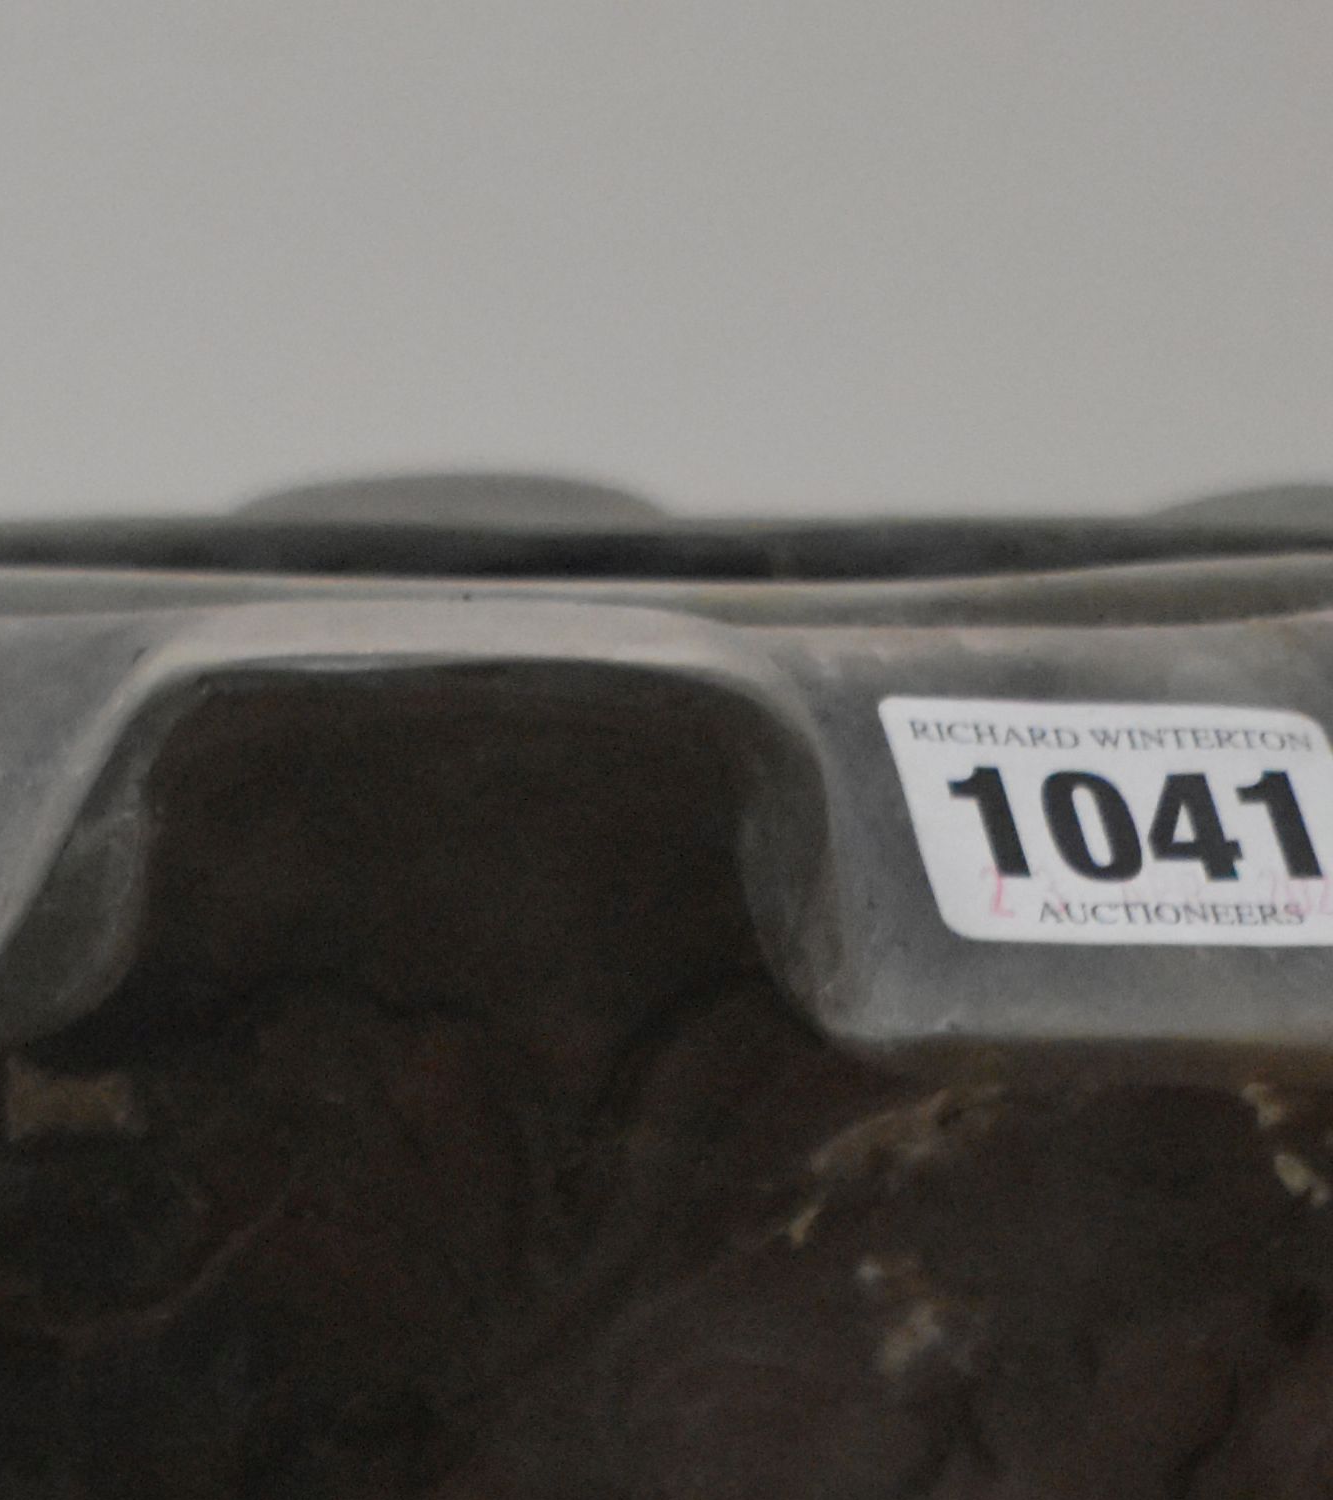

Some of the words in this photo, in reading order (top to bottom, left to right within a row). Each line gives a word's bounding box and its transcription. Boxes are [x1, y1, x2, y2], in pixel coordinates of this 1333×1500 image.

[909, 720, 1080, 749] RICHARD
[1089, 727, 1313, 752] WINTERTON
[947, 766, 1323, 882] 1041
[1039, 901, 1306, 926] AUCTIONEERS
